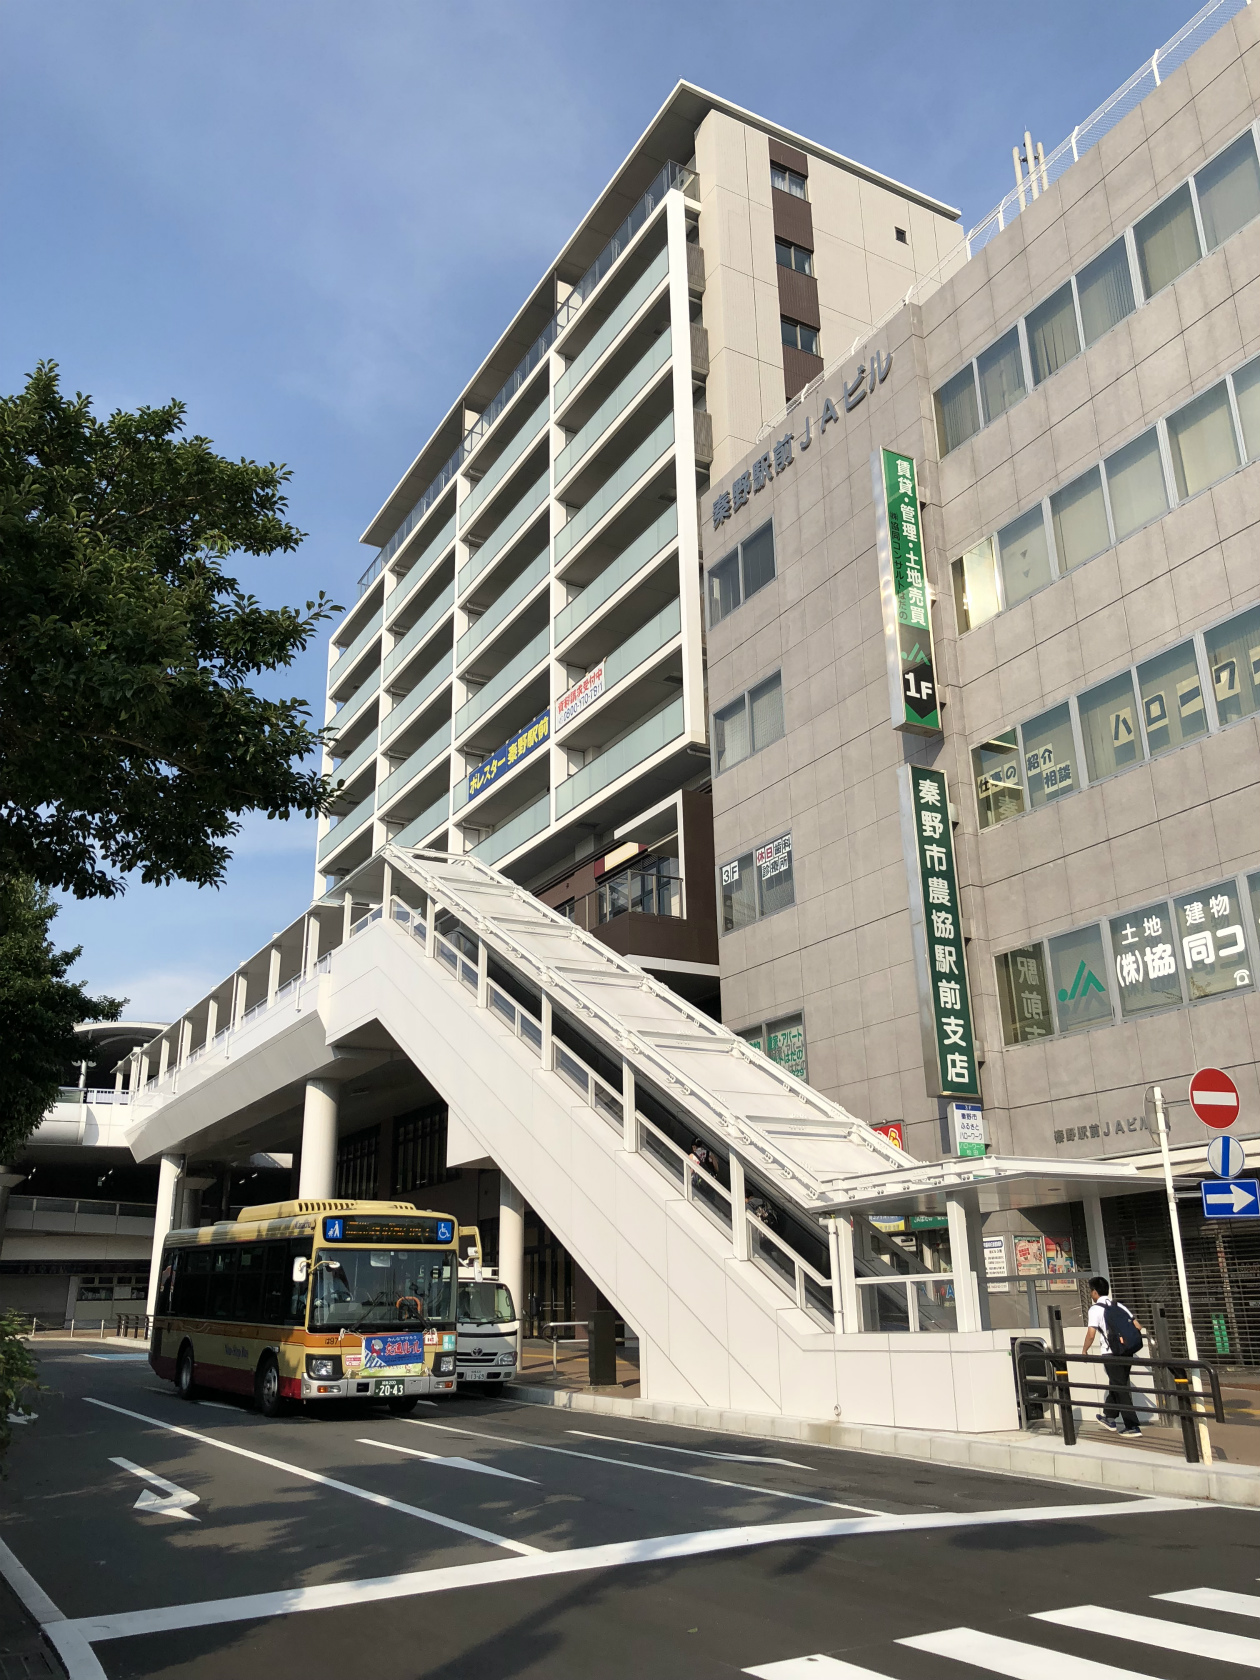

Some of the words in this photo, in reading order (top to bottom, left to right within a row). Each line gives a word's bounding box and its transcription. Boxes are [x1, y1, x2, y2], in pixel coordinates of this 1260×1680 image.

[713, 350, 892, 531] 秦野駅前JAビル
[896, 459, 926, 626] 賃貸・管理・土地売買
[557, 668, 603, 714] 資料請求受付中
[904, 672, 933, 700] 1F
[1026, 748, 1053, 772] 紹介
[1044, 764, 1072, 789] 相談
[724, 865, 738, 883] 3F
[918, 779, 969, 1083] 秦野市農協駅前支店
[1121, 915, 1162, 945] 土地
[1184, 894, 1230, 926] 建物
[960, 1132, 983, 1140] ハローワーク
[385, 1341, 422, 1355] 交通ルール
